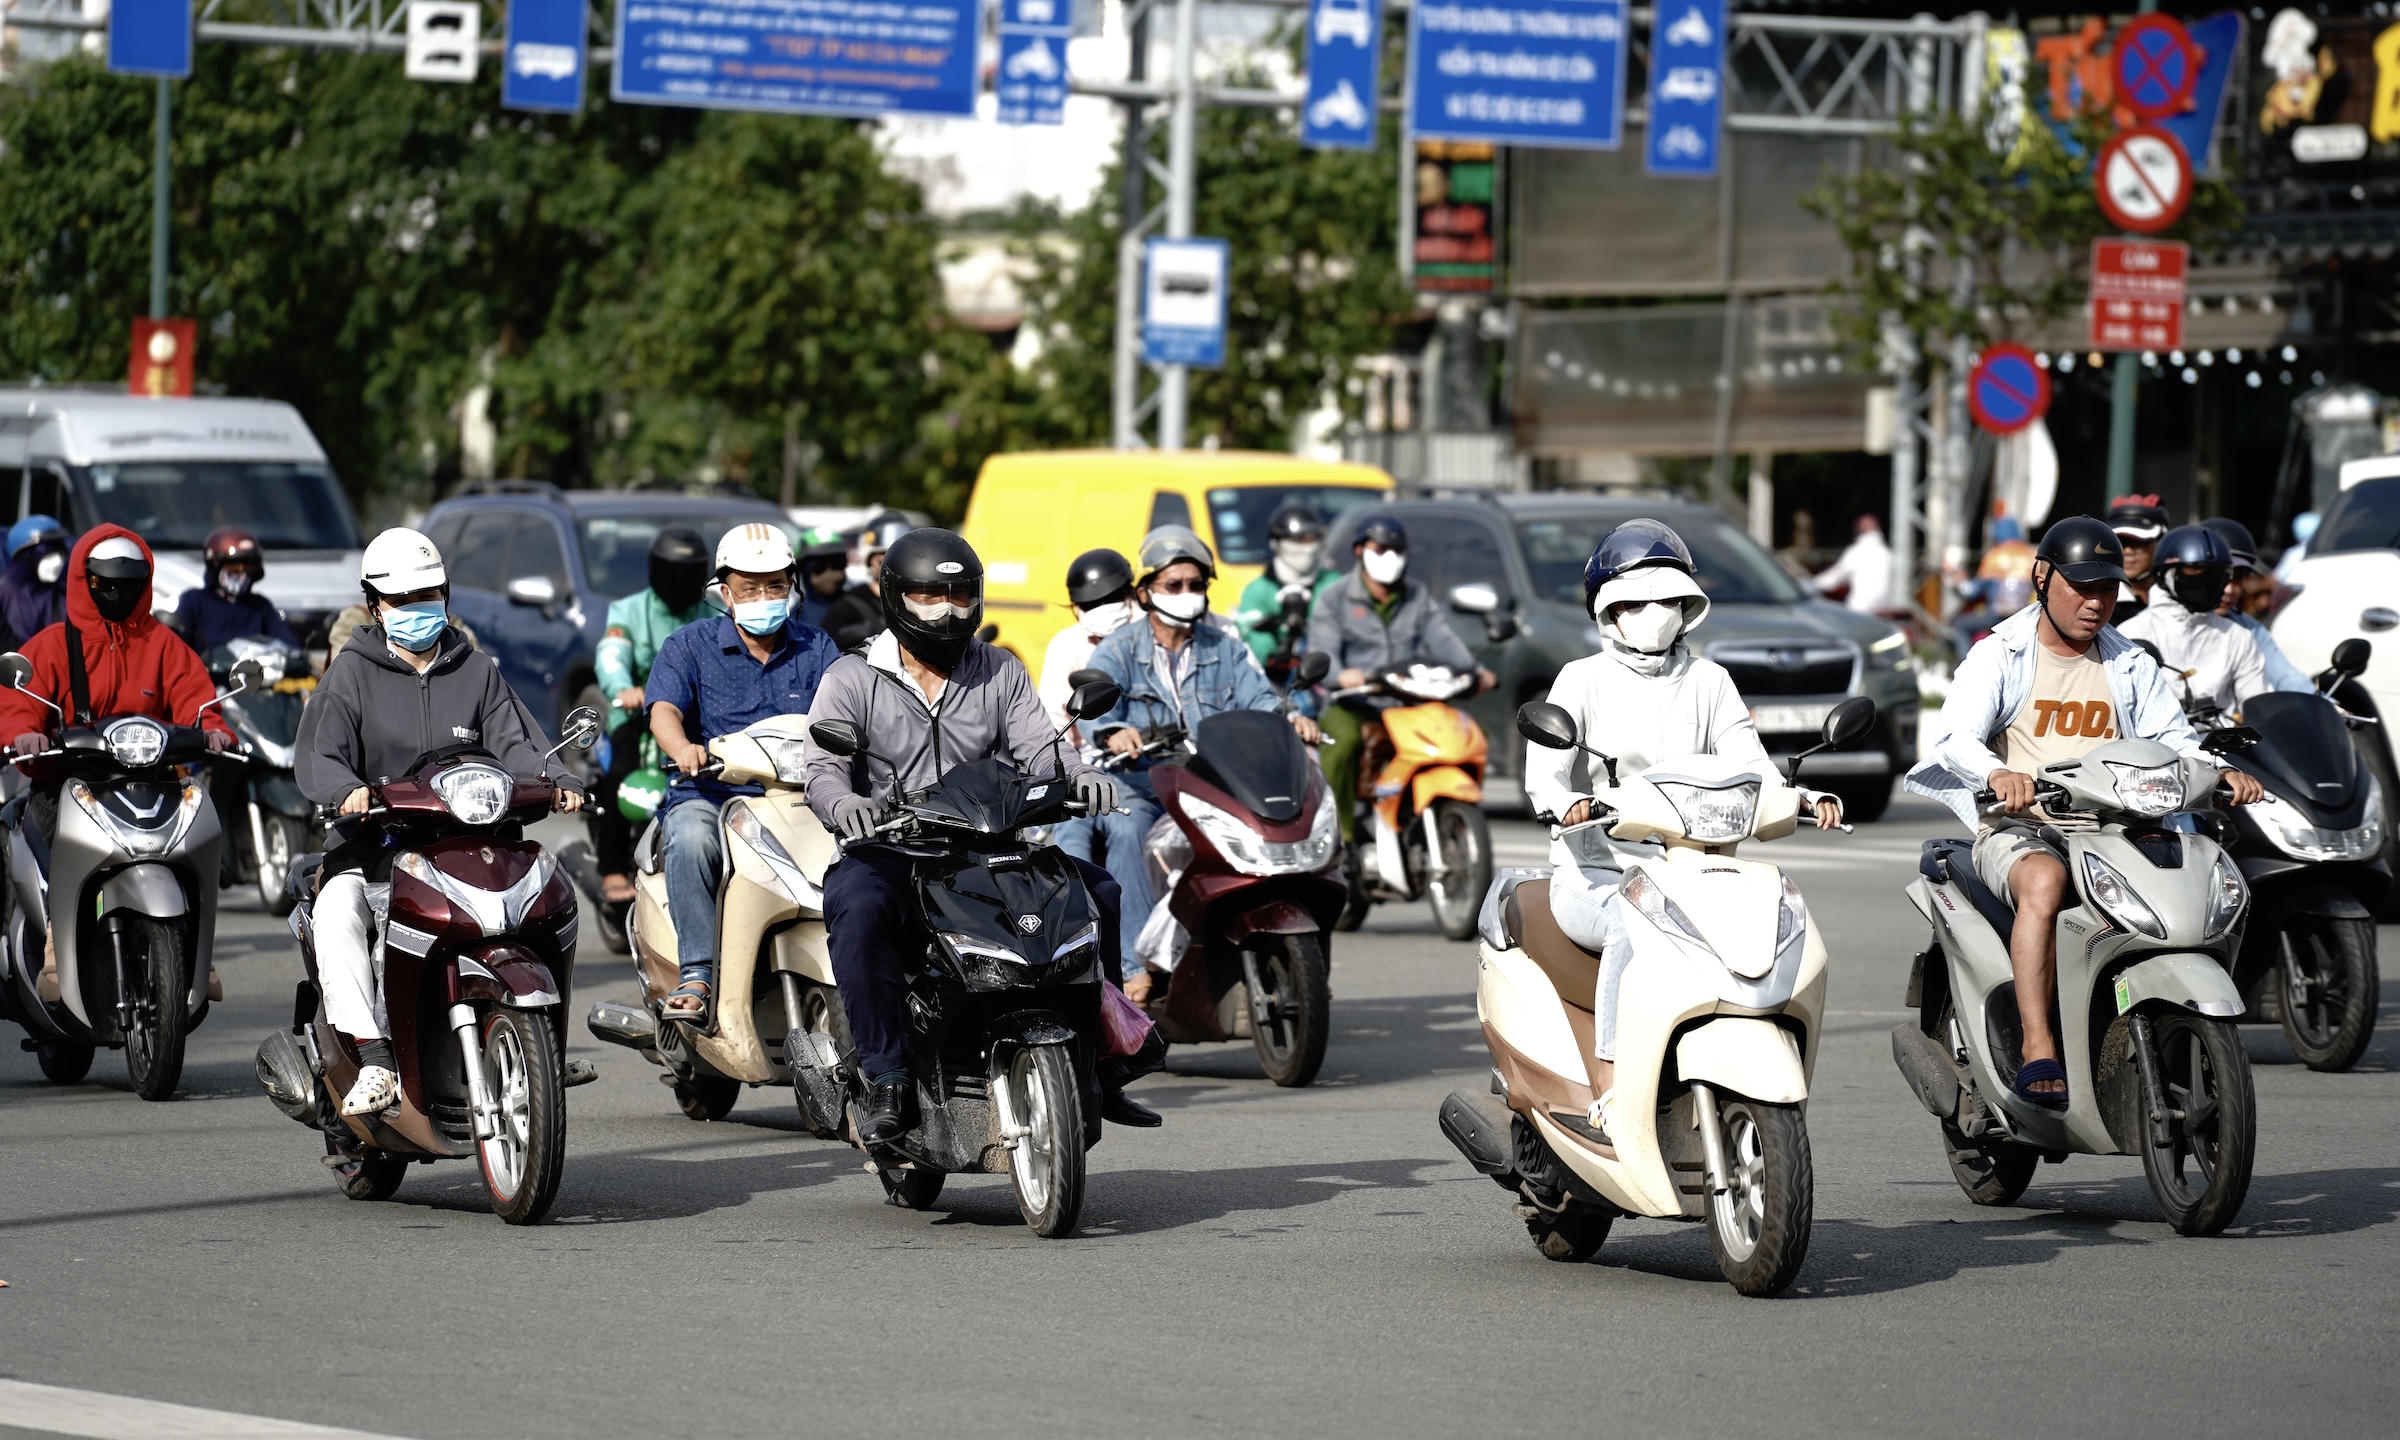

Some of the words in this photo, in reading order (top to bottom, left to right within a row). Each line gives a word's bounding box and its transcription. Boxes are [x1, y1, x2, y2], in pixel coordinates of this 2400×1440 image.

[2034, 699, 2114, 738] TOD.
[988, 855, 1022, 863] HONDA
[1935, 888, 1956, 911] VISION
